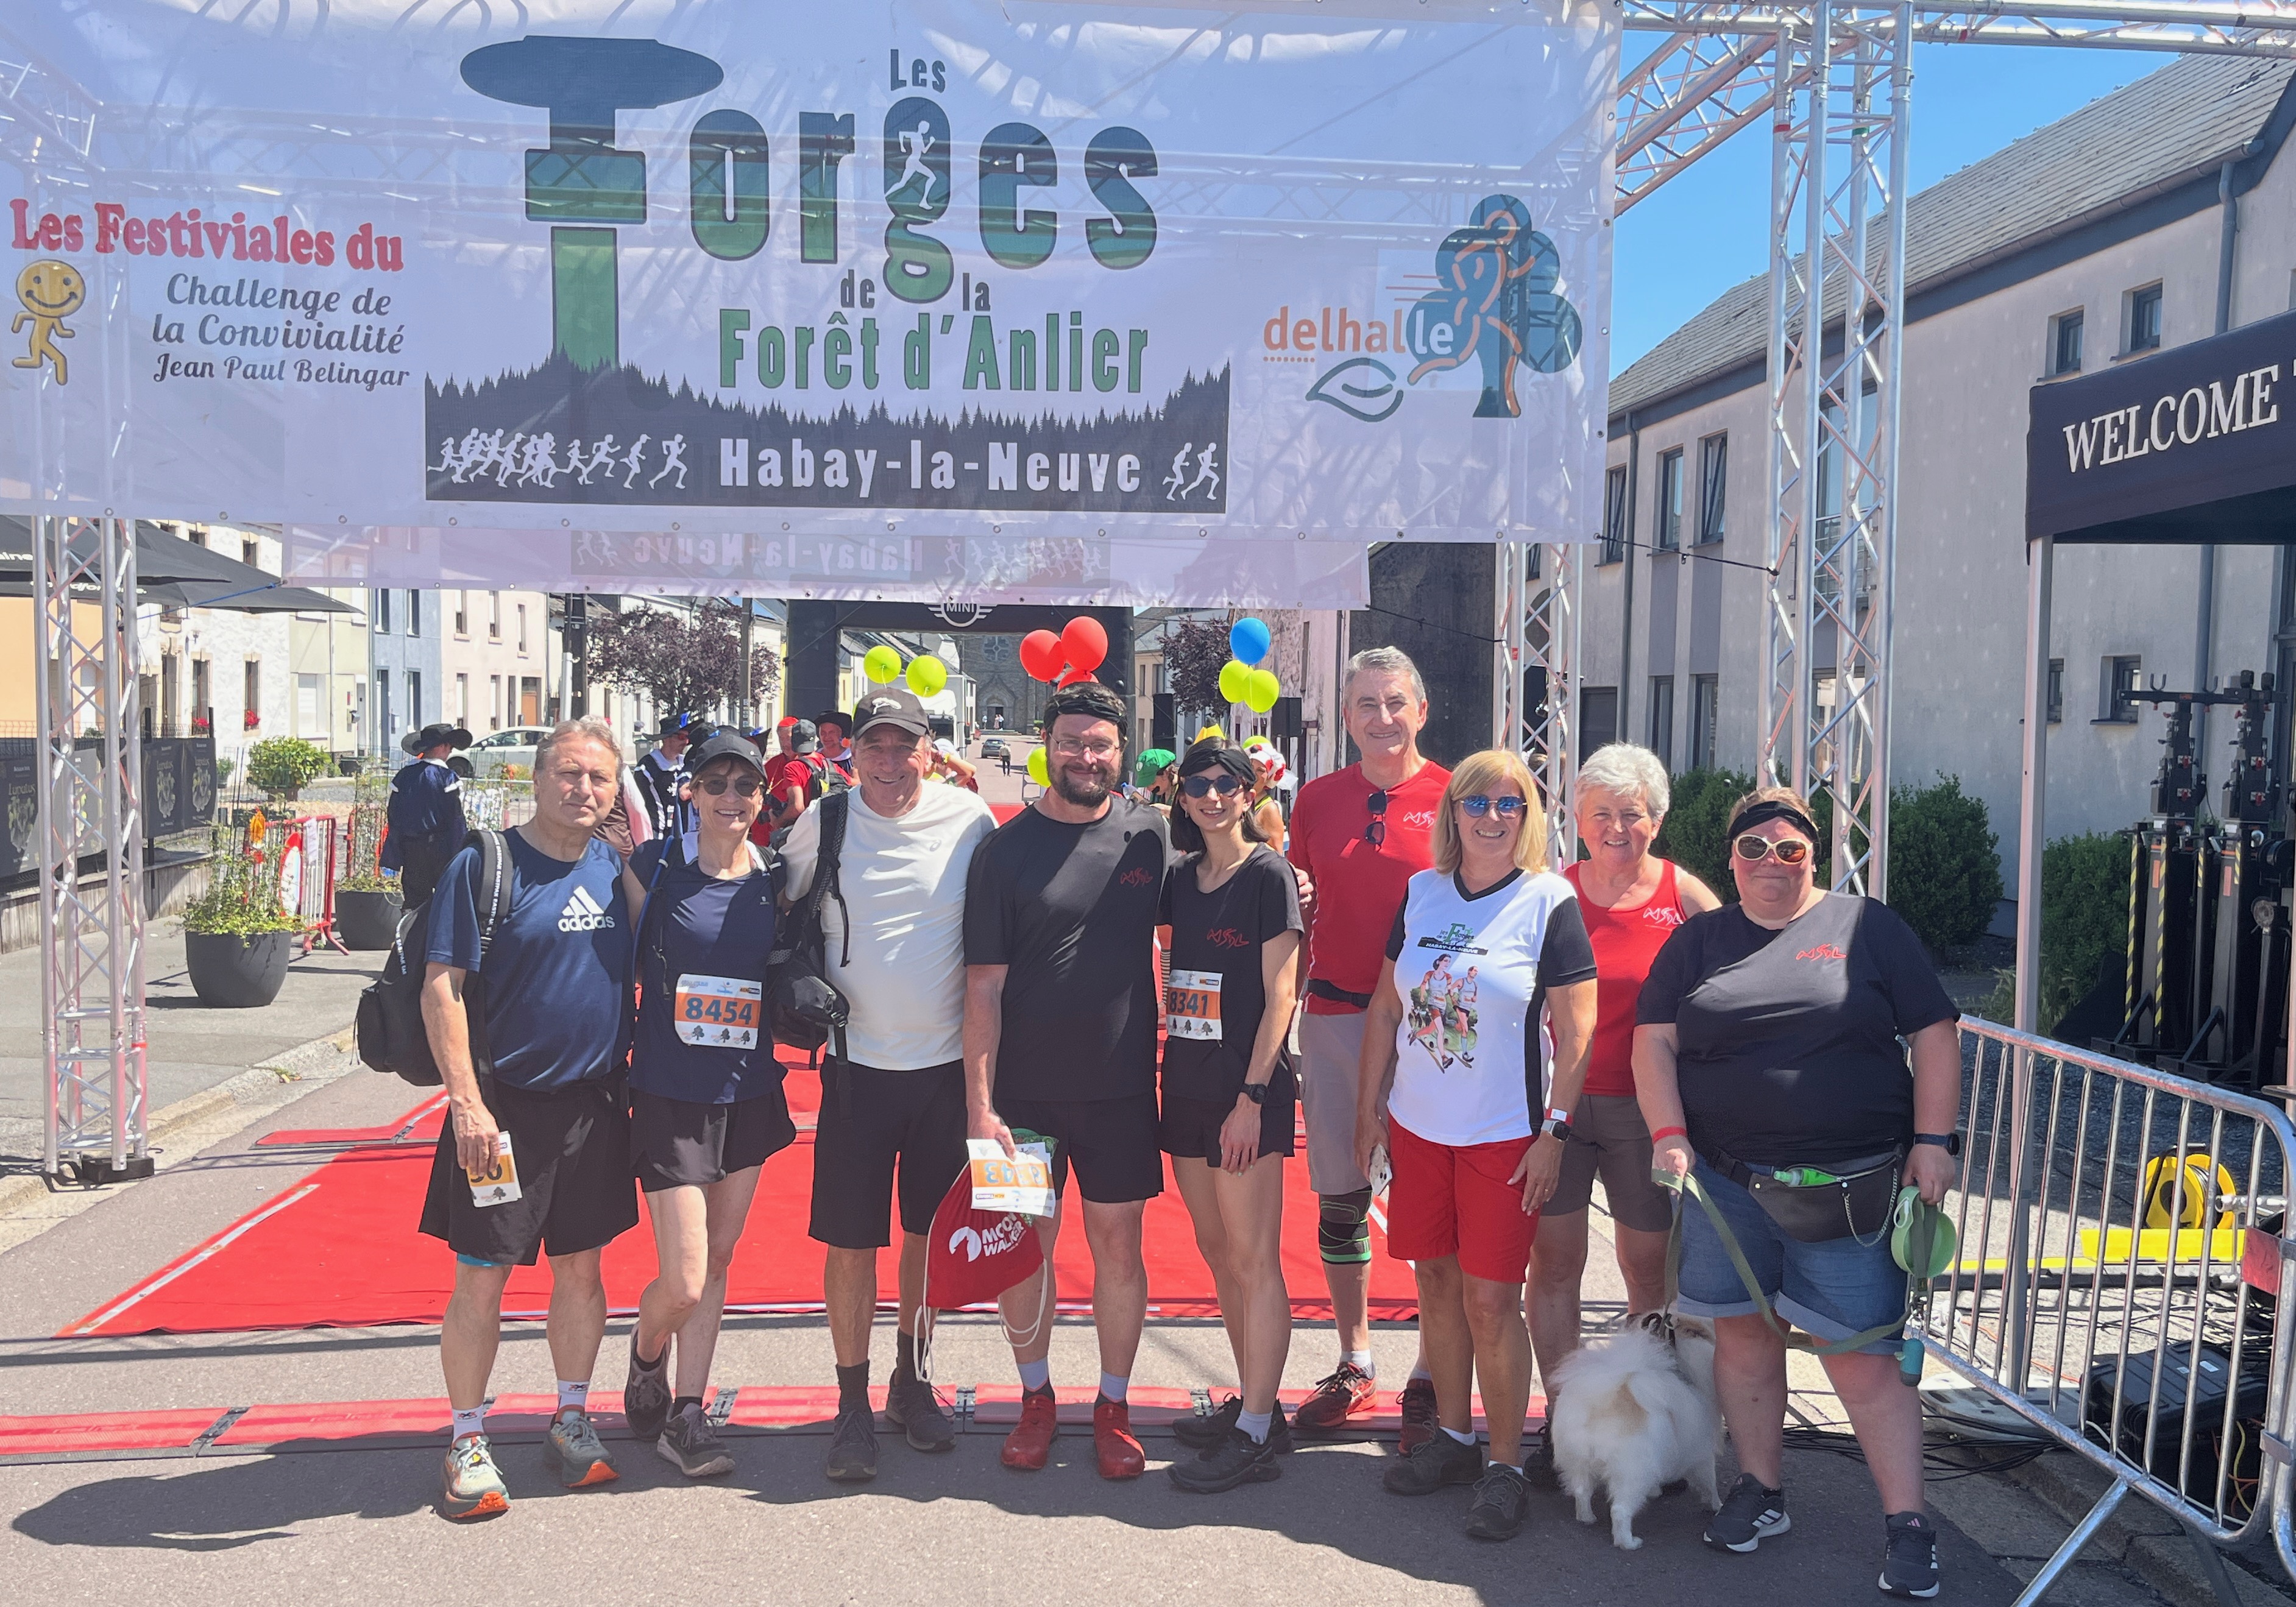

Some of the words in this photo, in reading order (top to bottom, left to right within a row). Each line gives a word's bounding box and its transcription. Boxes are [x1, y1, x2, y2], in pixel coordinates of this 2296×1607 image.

[890, 49, 946, 93] Les
[9, 199, 83, 252] Les
[94, 202, 335, 267] Festiviales
[346, 222, 405, 272] du
[166, 272, 341, 320] Challenge
[352, 287, 391, 316] de
[840, 270, 874, 308] de
[963, 273, 991, 312] la
[152, 313, 185, 344] la
[197, 313, 405, 355] Convivialité
[720, 309, 880, 390] Forêt
[904, 311, 1149, 394] d'Anlier
[1263, 306, 1454, 355] delhalle
[153, 353, 214, 383] Jean
[224, 356, 286, 381] Paul
[293, 359, 410, 392] Belingar
[2063, 364, 2279, 473] WELCOME
[720, 437, 1141, 499] Habay-la-Neuve
[946, 602, 974, 613] MINI
[558, 914, 615, 932] addas
[685, 997, 753, 1025] 8454
[1170, 991, 1208, 1016] 8341
